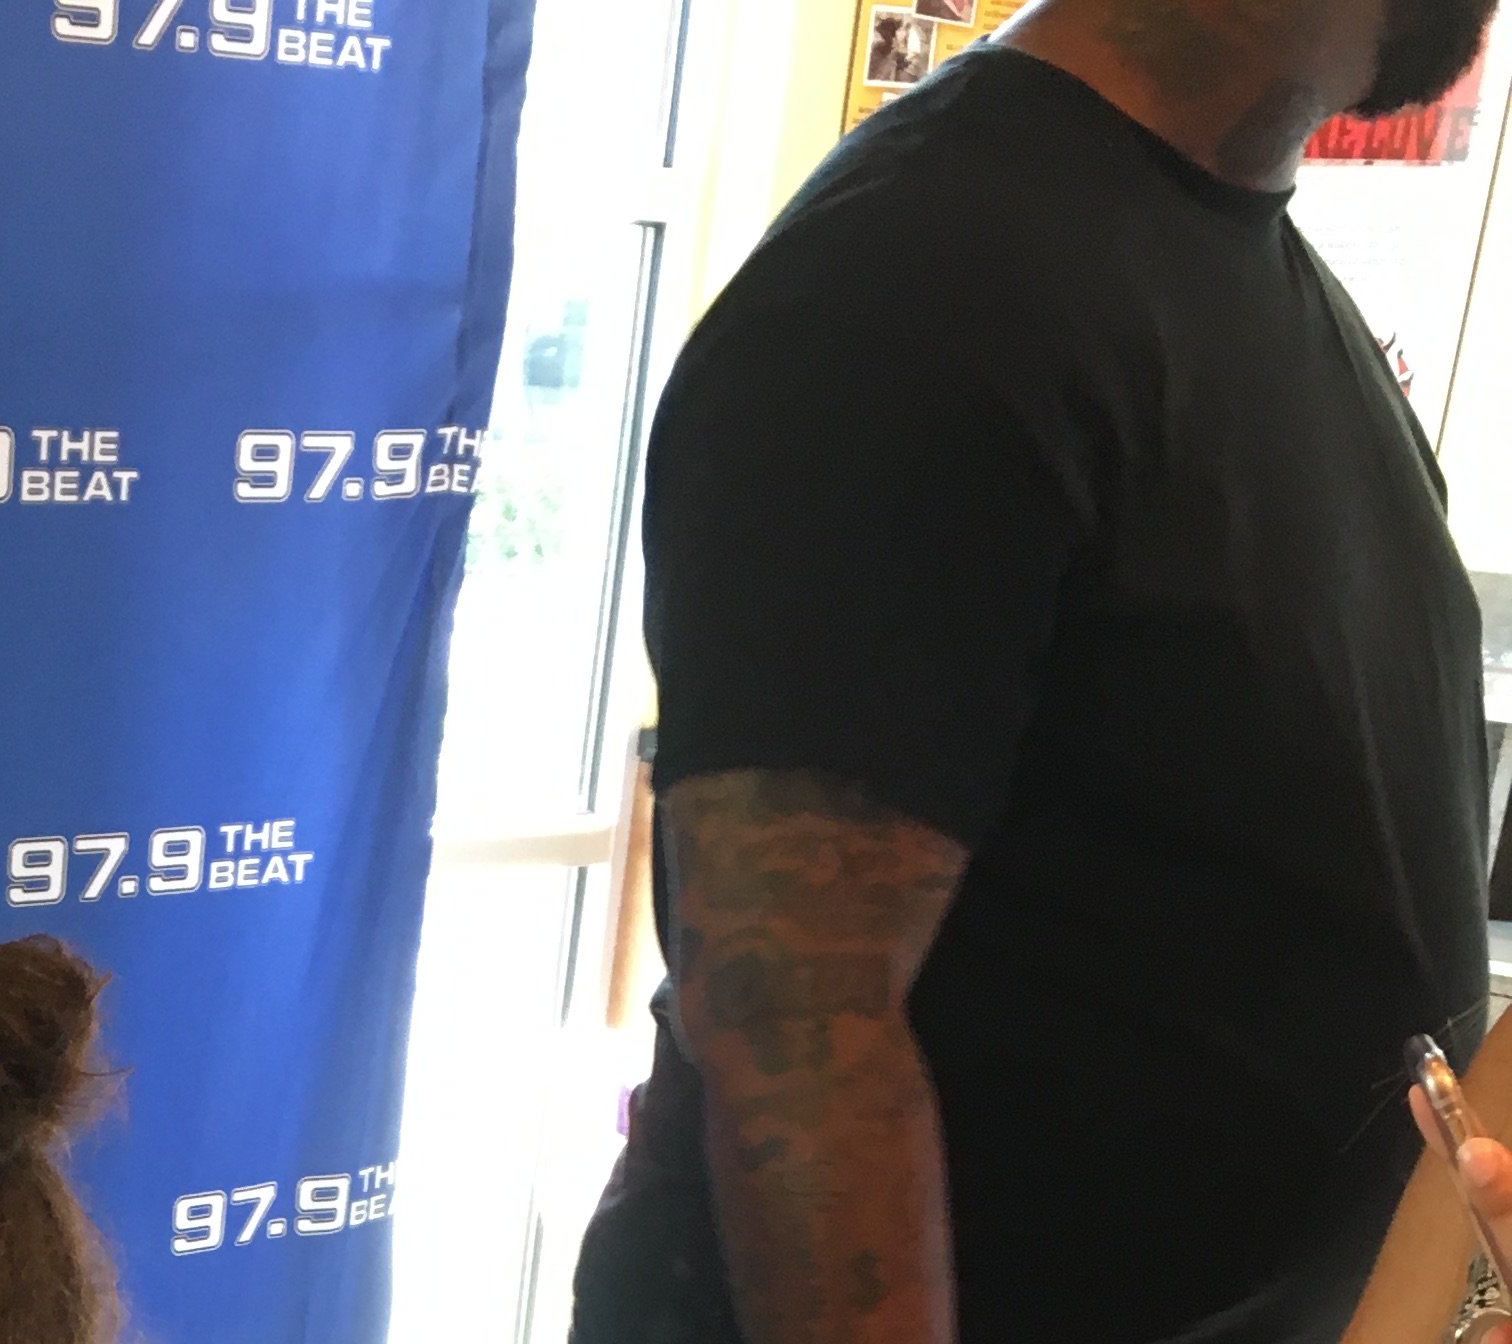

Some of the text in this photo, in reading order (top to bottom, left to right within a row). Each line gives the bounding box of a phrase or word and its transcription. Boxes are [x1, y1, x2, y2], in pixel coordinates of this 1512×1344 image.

[276, 28, 392, 72] BEAT
[30, 429, 121, 463] THE
[437, 424, 488, 457] TH
[233, 429, 427, 502] 97.9
[20, 468, 140, 502] BEAT
[220, 818, 296, 853] THE
[6, 826, 206, 907] 97.9
[208, 851, 314, 890] BEAT
[358, 1161, 397, 1194] TH
[171, 1173, 351, 1257] 97.9
